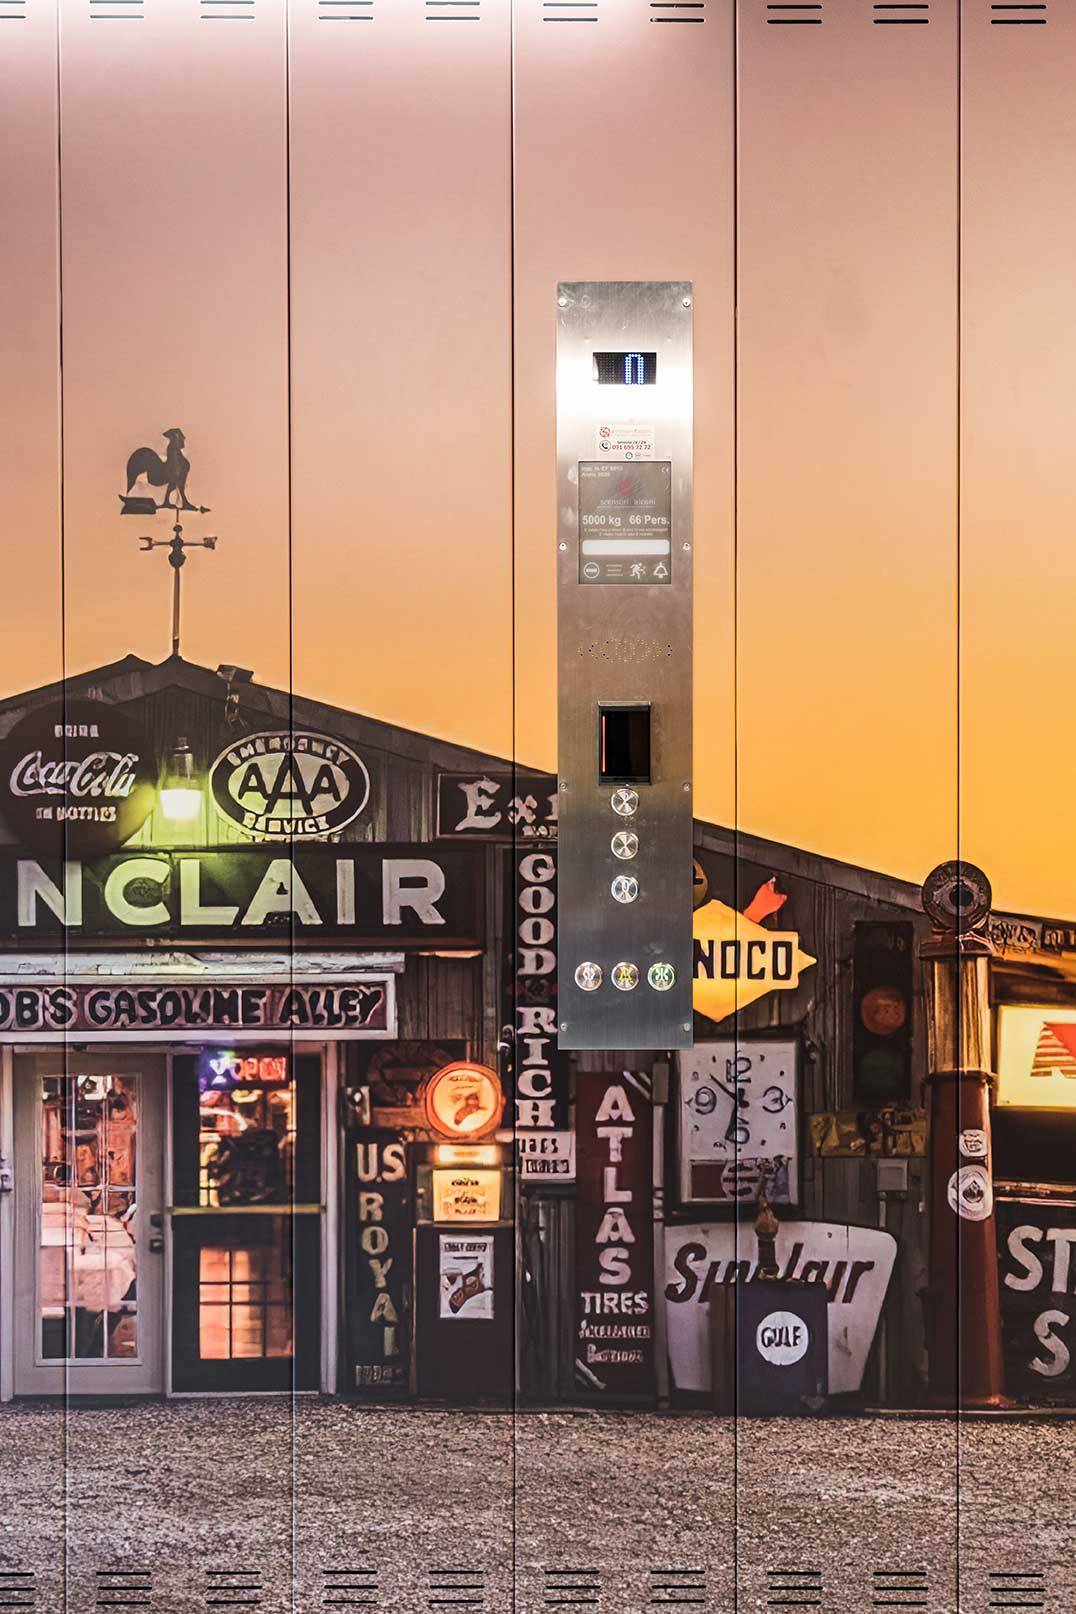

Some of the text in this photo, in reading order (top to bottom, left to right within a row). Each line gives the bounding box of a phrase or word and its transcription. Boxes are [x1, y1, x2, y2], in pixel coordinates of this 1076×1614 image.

[582, 514, 670, 527] 5000 kg 66 Pers.
[237, 751, 342, 816] AAA
[16, 857, 446, 927] NCLAIR
[278, 988, 384, 1025] ALLEY
[594, 1085, 637, 1285] ATLAS
[664, 1242, 875, 1304] Sinlair
[1003, 1225, 1076, 1294] ST
[581, 1290, 650, 1315] TIRES
